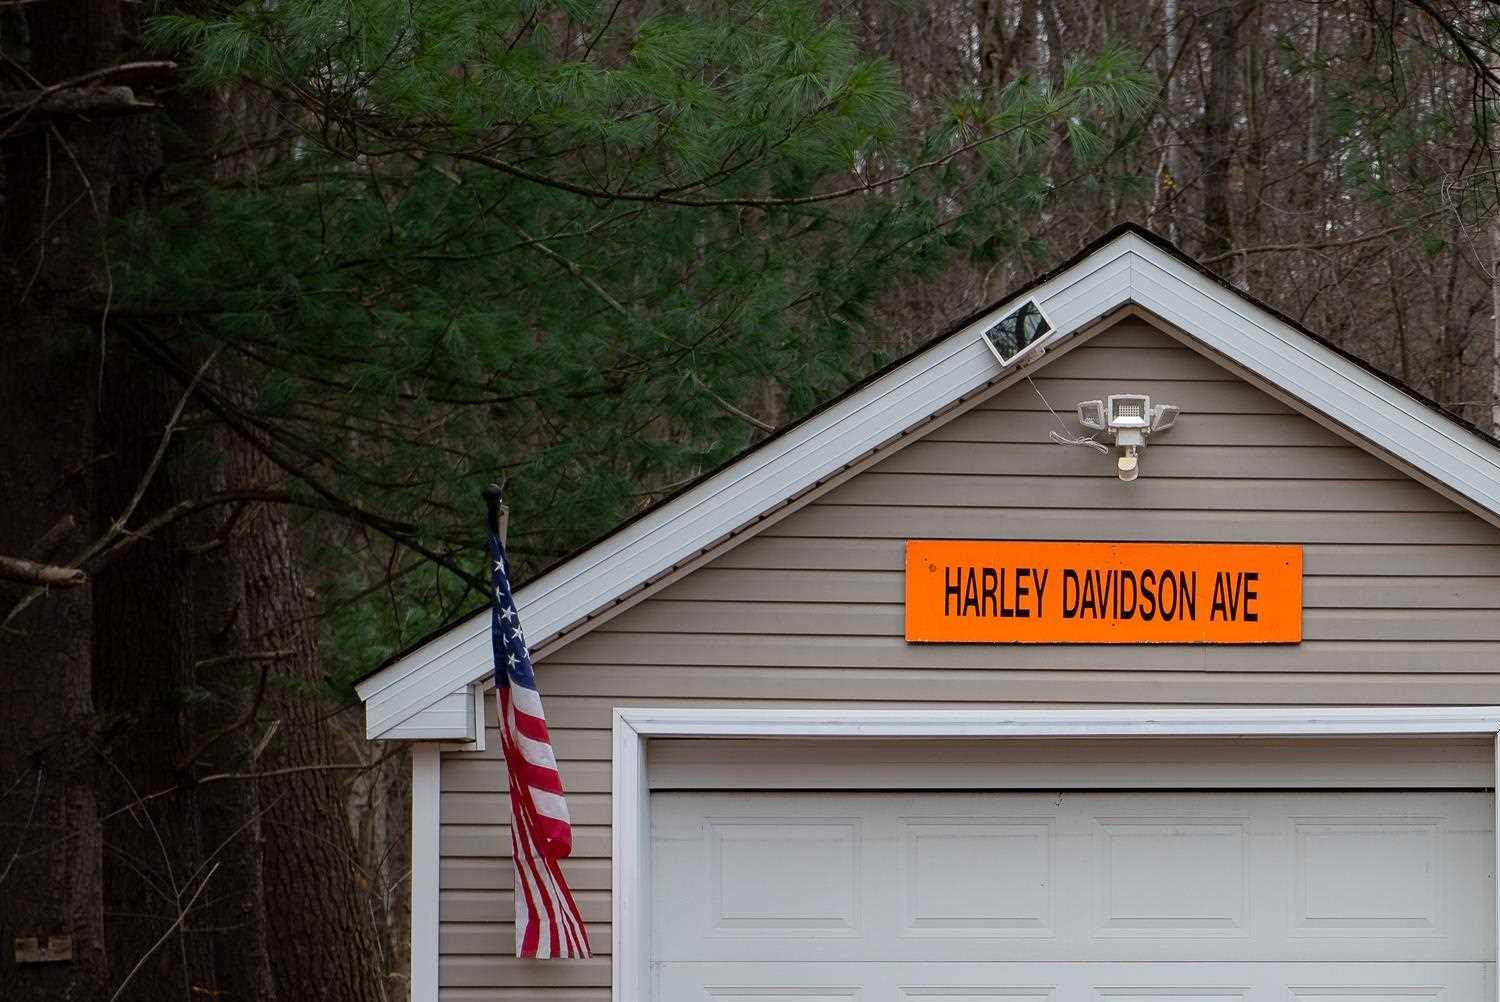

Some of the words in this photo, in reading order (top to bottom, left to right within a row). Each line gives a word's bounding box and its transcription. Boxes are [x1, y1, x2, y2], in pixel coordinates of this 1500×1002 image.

[944, 566, 1048, 618] HARLEY
[1062, 568, 1197, 621] DAVIDSON
[1209, 571, 1259, 622] AVE
